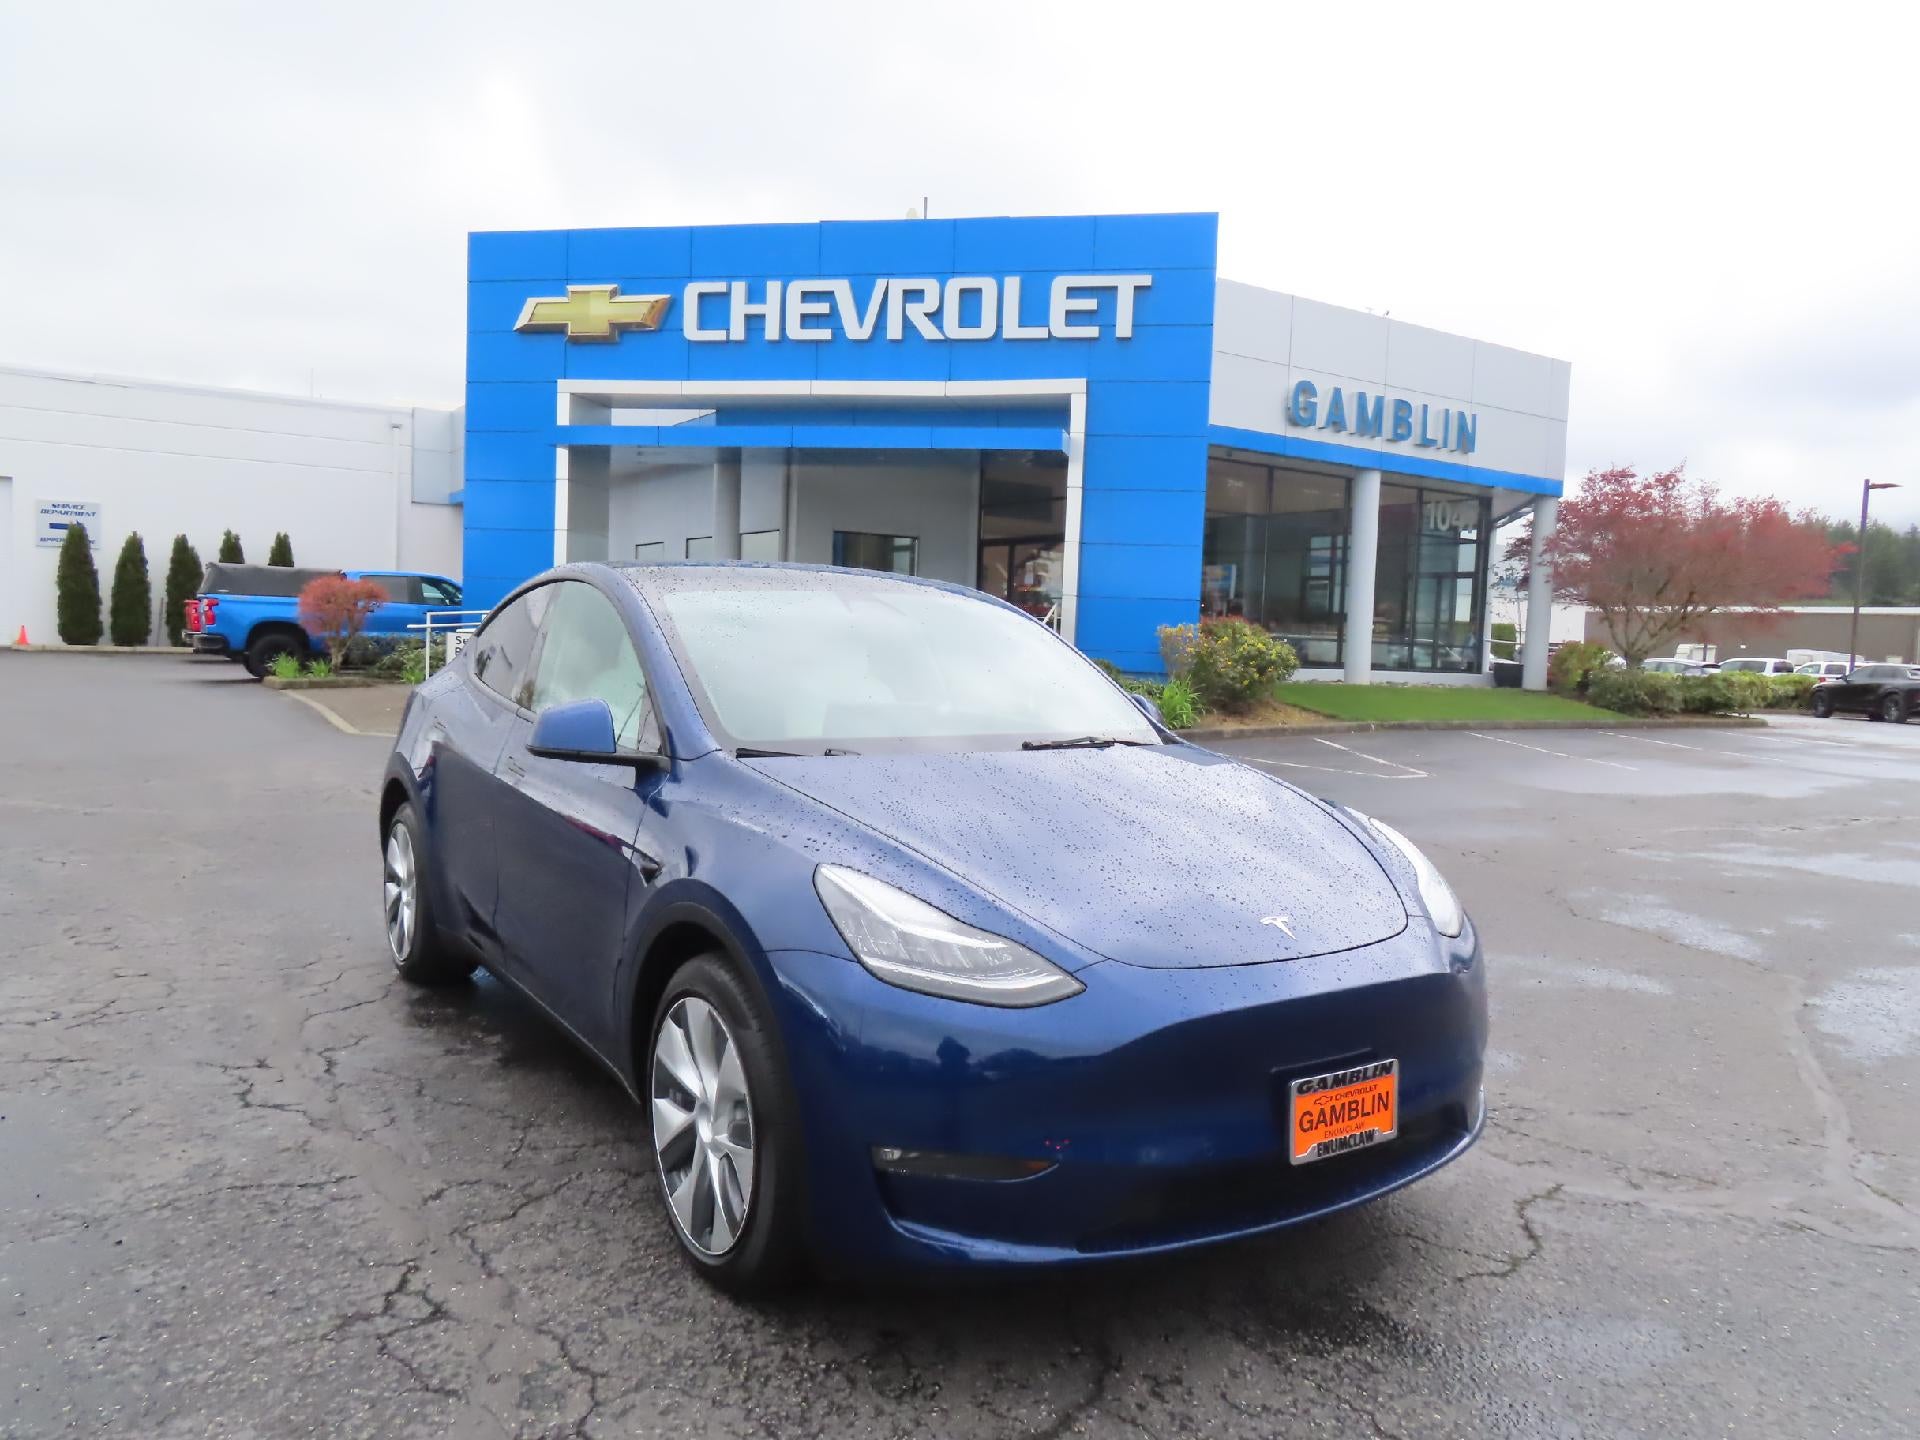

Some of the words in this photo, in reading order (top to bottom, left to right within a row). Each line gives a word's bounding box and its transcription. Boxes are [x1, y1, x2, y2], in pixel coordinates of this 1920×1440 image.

[683, 273, 1153, 343] CHEVROLET
[1288, 380, 1477, 454] GAMBLIN
[1297, 1061, 1394, 1095] GAMBLIN
[1335, 1084, 1378, 1102] CHEVROLET
[1298, 1091, 1390, 1133] GAMBLIN
[1317, 1128, 1375, 1157] ENUMCLAW
